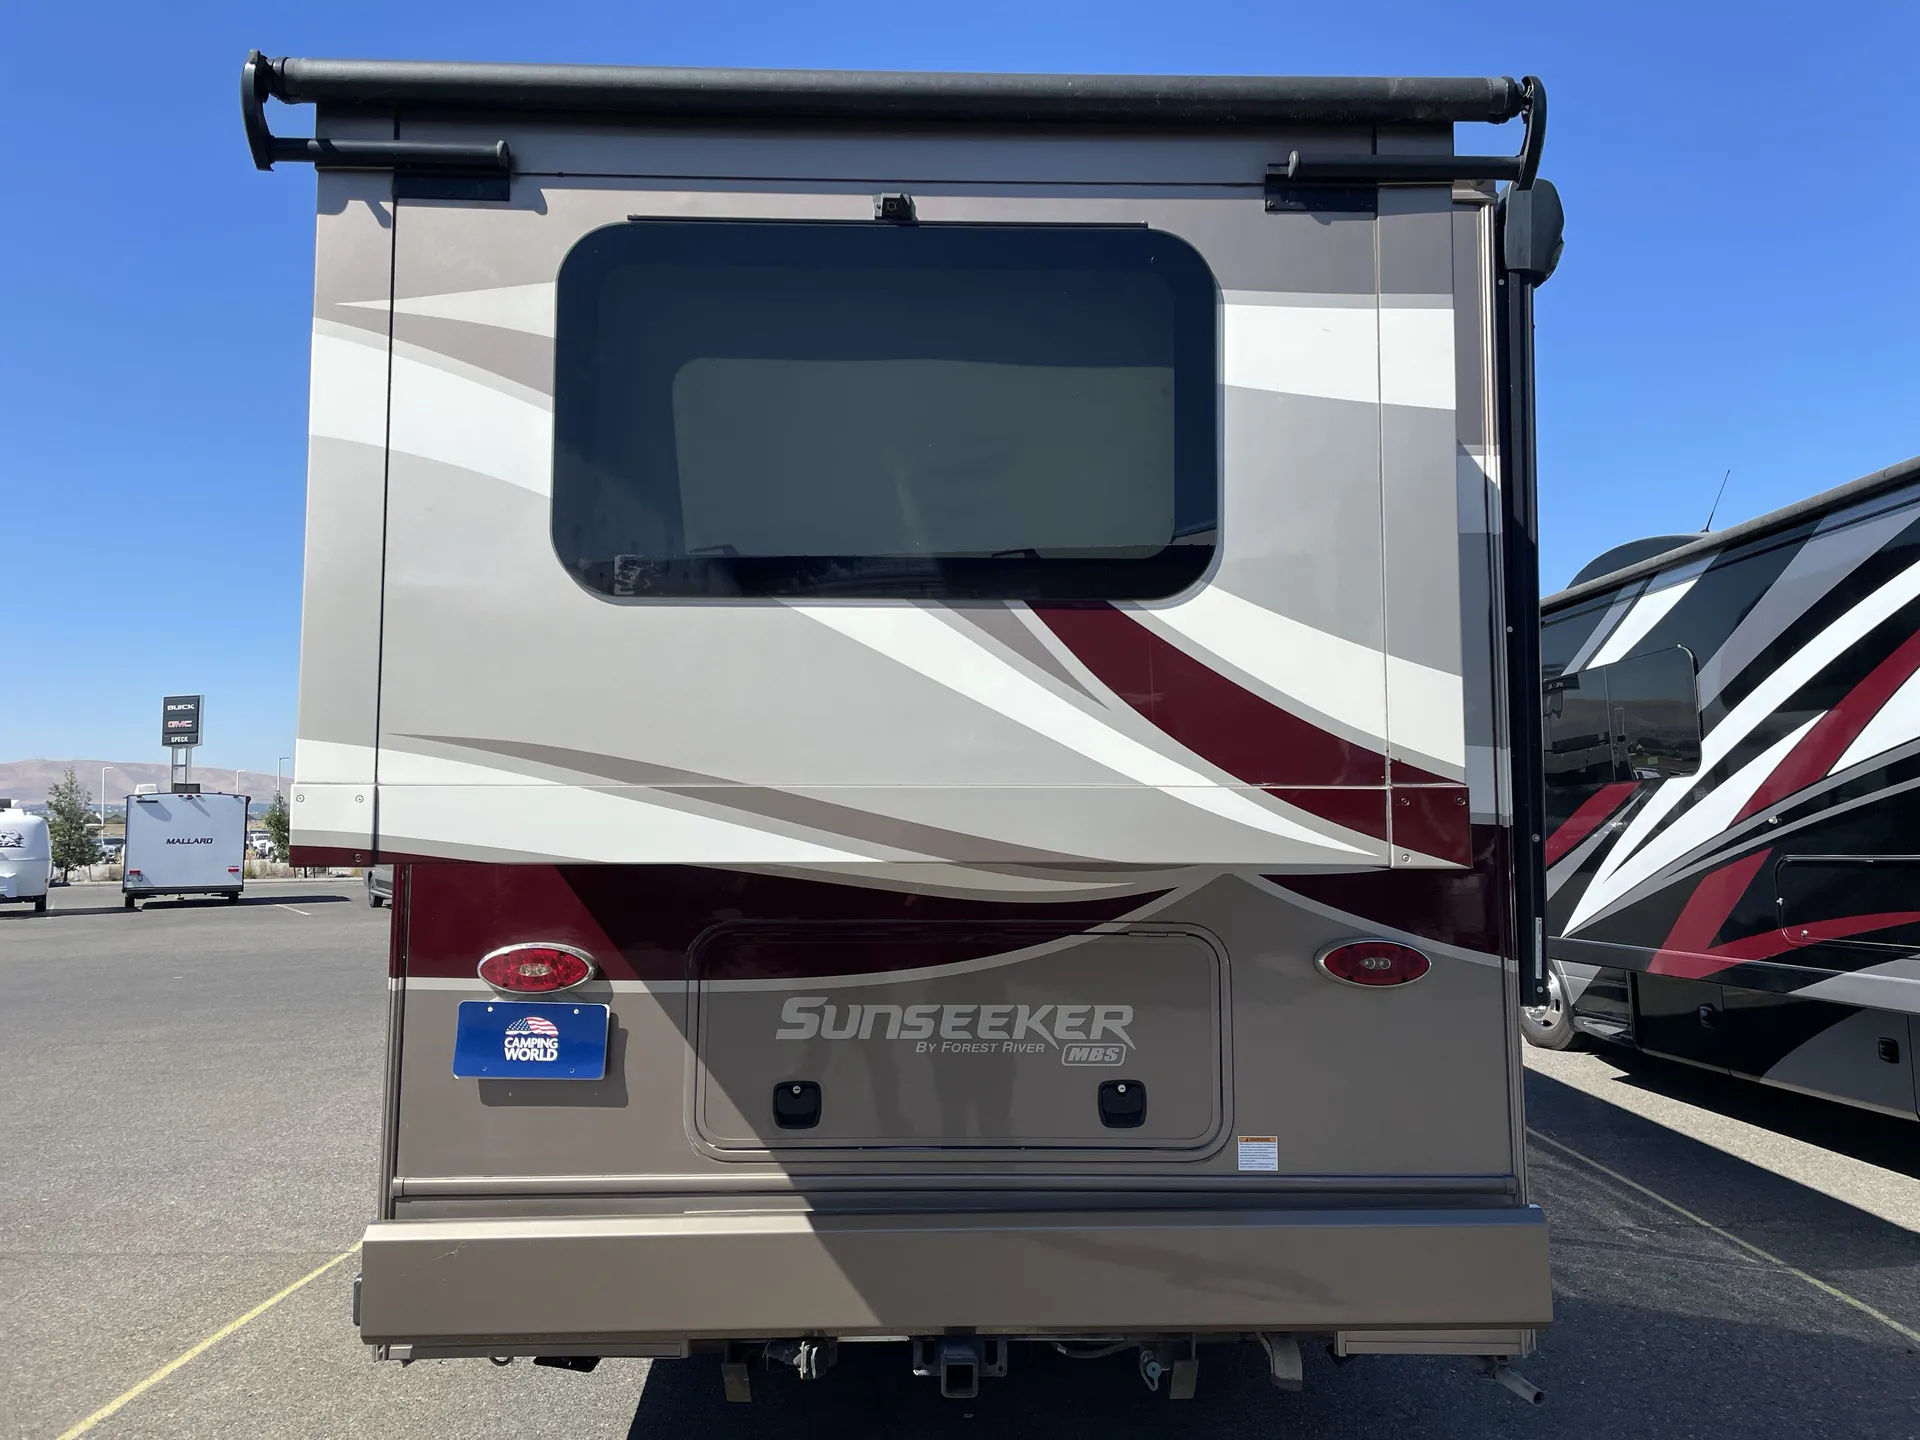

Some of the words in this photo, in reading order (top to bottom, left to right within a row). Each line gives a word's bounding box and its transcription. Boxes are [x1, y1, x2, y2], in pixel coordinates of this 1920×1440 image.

[775, 996, 1136, 1050] SUNSEEKER
[504, 1037, 558, 1048] CAMPING
[915, 1041, 937, 1053] BY
[941, 1041, 998, 1053] FOREST
[1002, 1041, 1045, 1053] RIVER
[504, 1048, 558, 1061] WORLD
[1067, 1047, 1120, 1062] MBS
